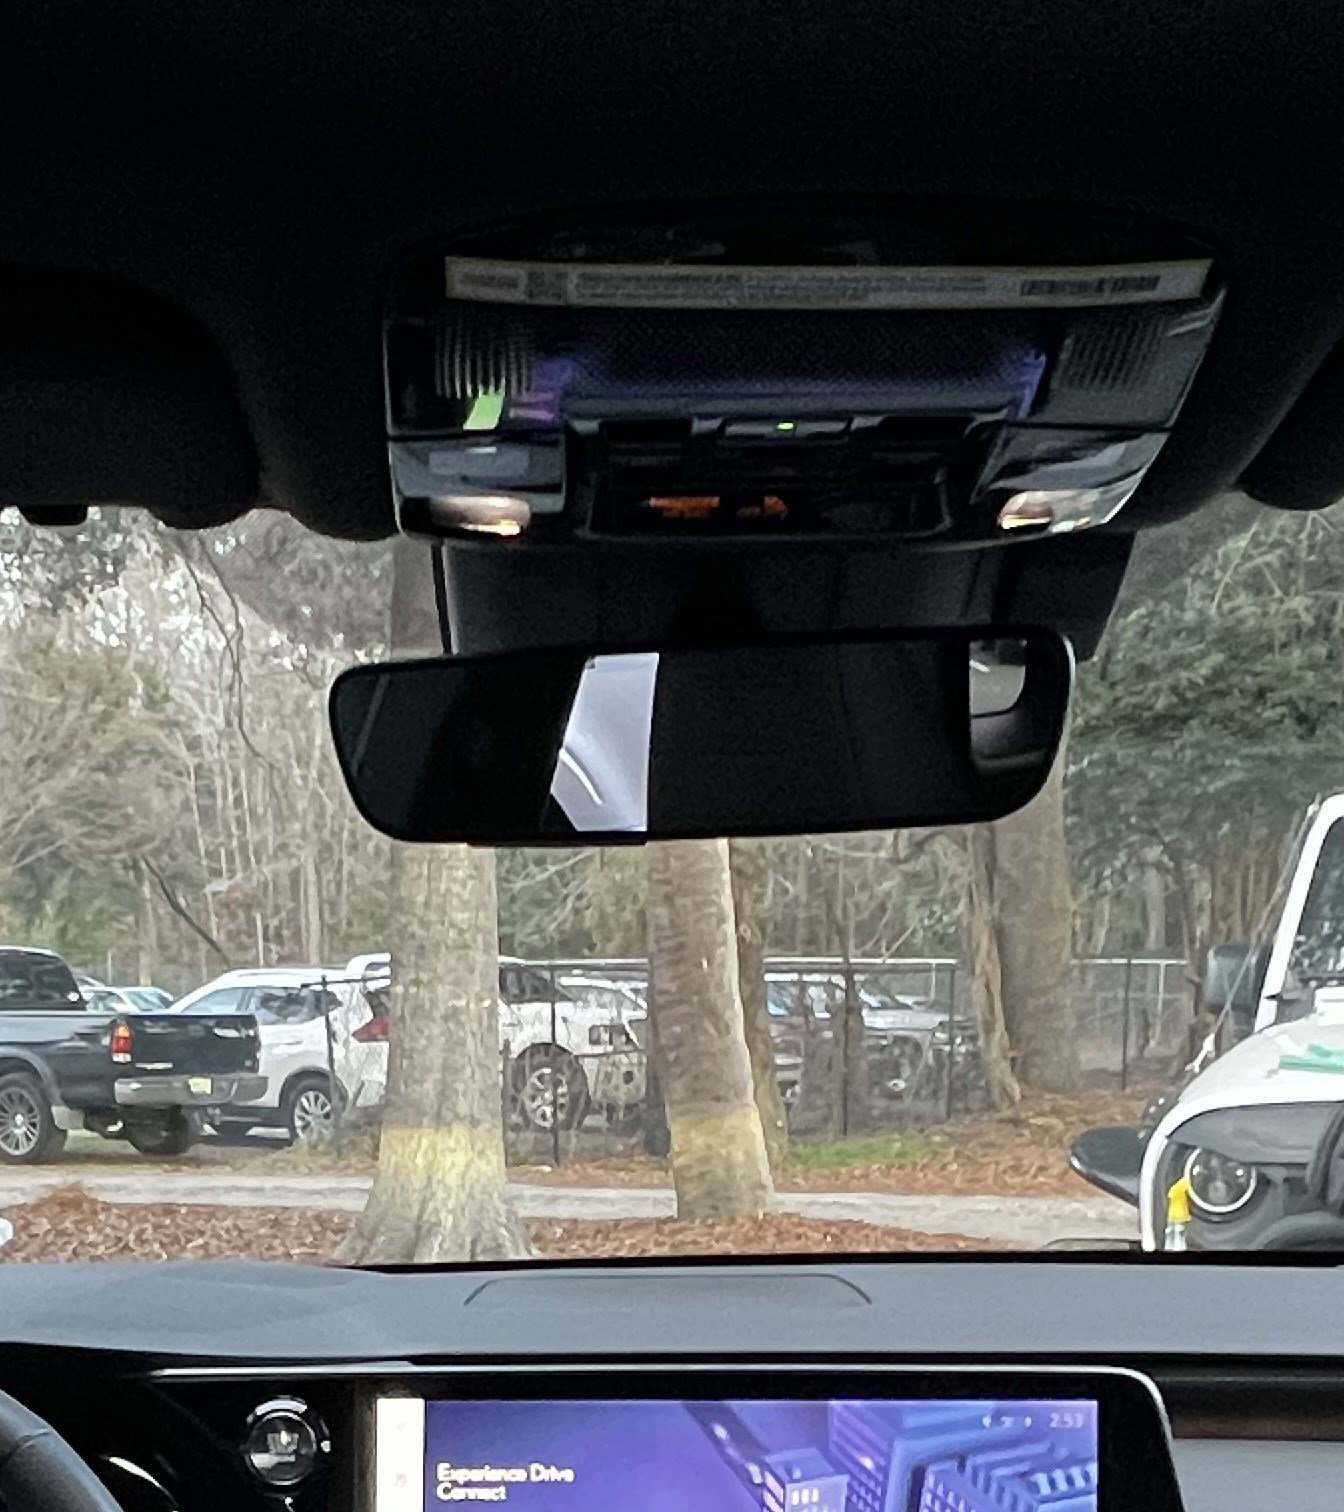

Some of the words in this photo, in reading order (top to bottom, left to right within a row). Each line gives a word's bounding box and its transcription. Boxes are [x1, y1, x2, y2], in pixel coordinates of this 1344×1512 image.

[436, 1462, 528, 1485] Experience
[529, 1462, 575, 1483] Drive
[436, 1482, 507, 1501] Connect
